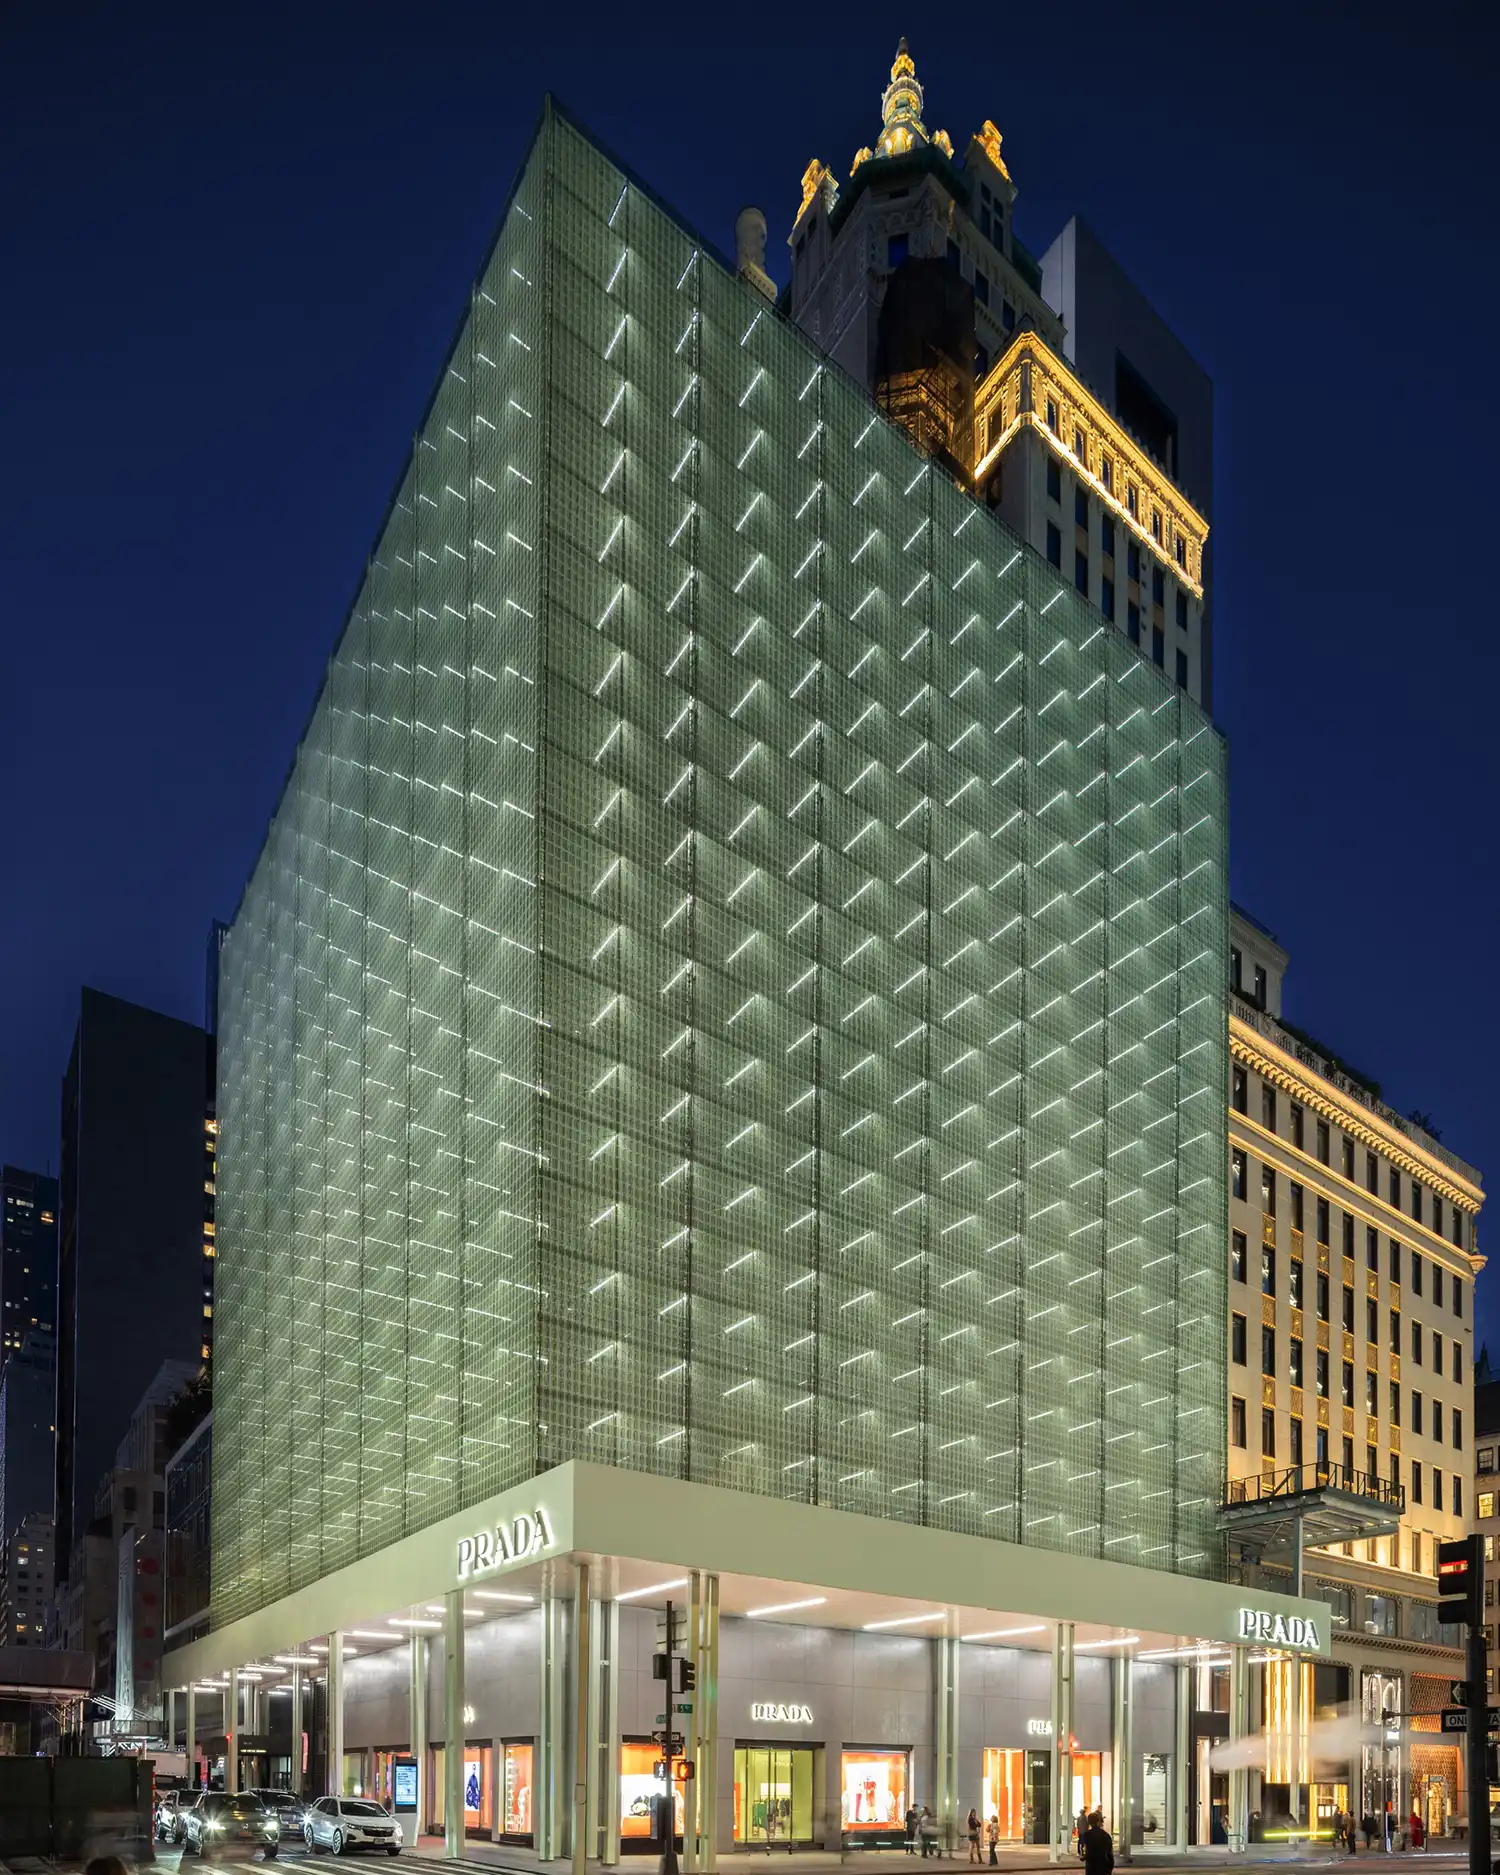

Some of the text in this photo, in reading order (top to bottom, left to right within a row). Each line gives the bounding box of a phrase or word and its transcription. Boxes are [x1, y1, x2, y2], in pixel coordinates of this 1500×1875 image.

[457, 1510, 551, 1576] PRADA
[1241, 1609, 1320, 1647] PRADA
[753, 1704, 813, 1722] PRADA
